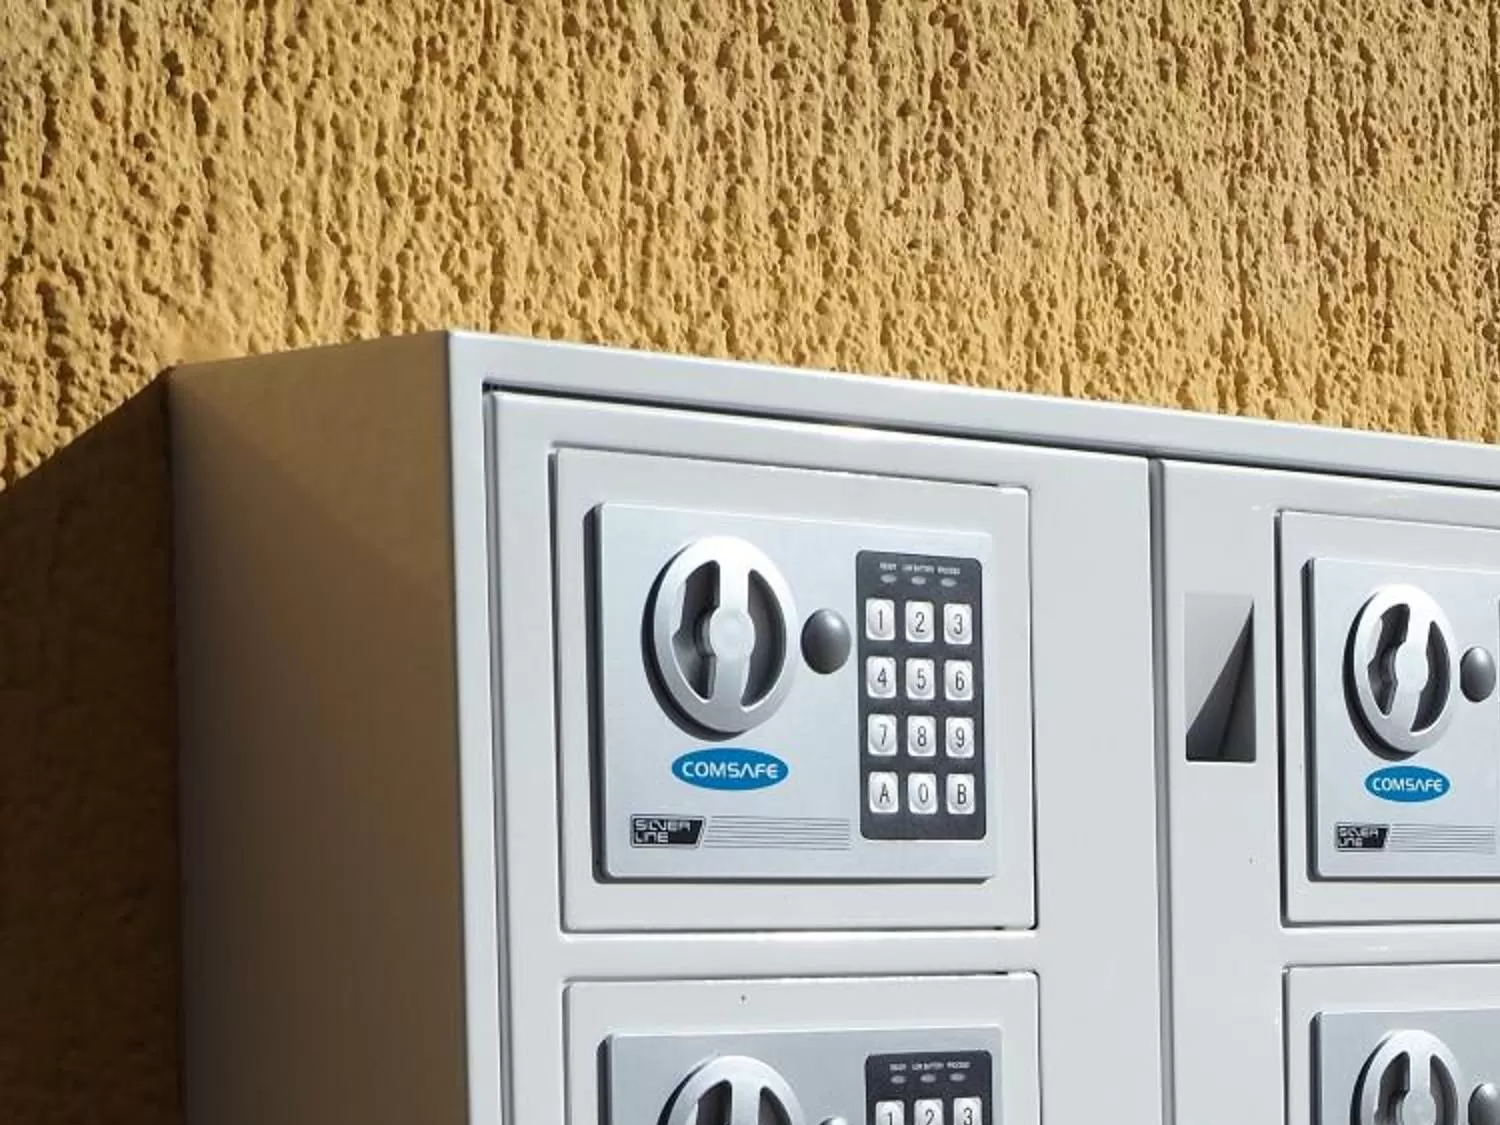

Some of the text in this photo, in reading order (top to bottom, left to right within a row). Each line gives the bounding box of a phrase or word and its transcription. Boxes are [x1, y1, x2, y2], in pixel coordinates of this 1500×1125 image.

[914, 612, 926, 634] 2
[952, 613, 964, 635] 3
[876, 668, 966, 691] 4 5 6
[877, 724, 966, 748] 7 8 9
[681, 761, 779, 779] COMSAFE
[878, 784, 968, 805] A 0 B
[1372, 778, 1443, 792] COMSAFE
